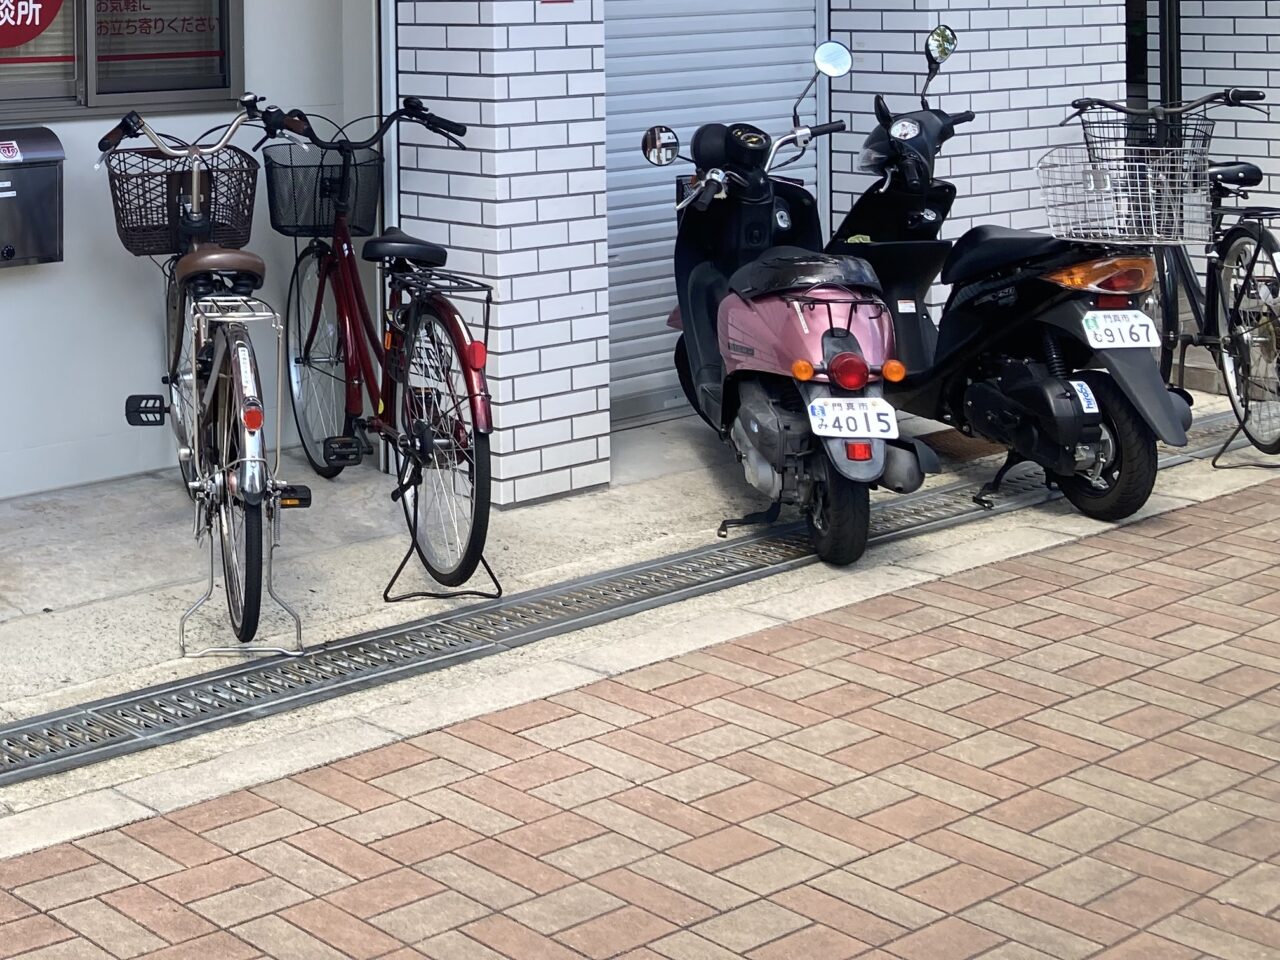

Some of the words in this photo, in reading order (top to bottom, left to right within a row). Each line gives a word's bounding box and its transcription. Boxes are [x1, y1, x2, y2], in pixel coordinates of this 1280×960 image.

[96, 16, 220, 36] お立ち寄りください
[1104, 323, 1150, 343] 9167
[832, 412, 891, 433] 4015
